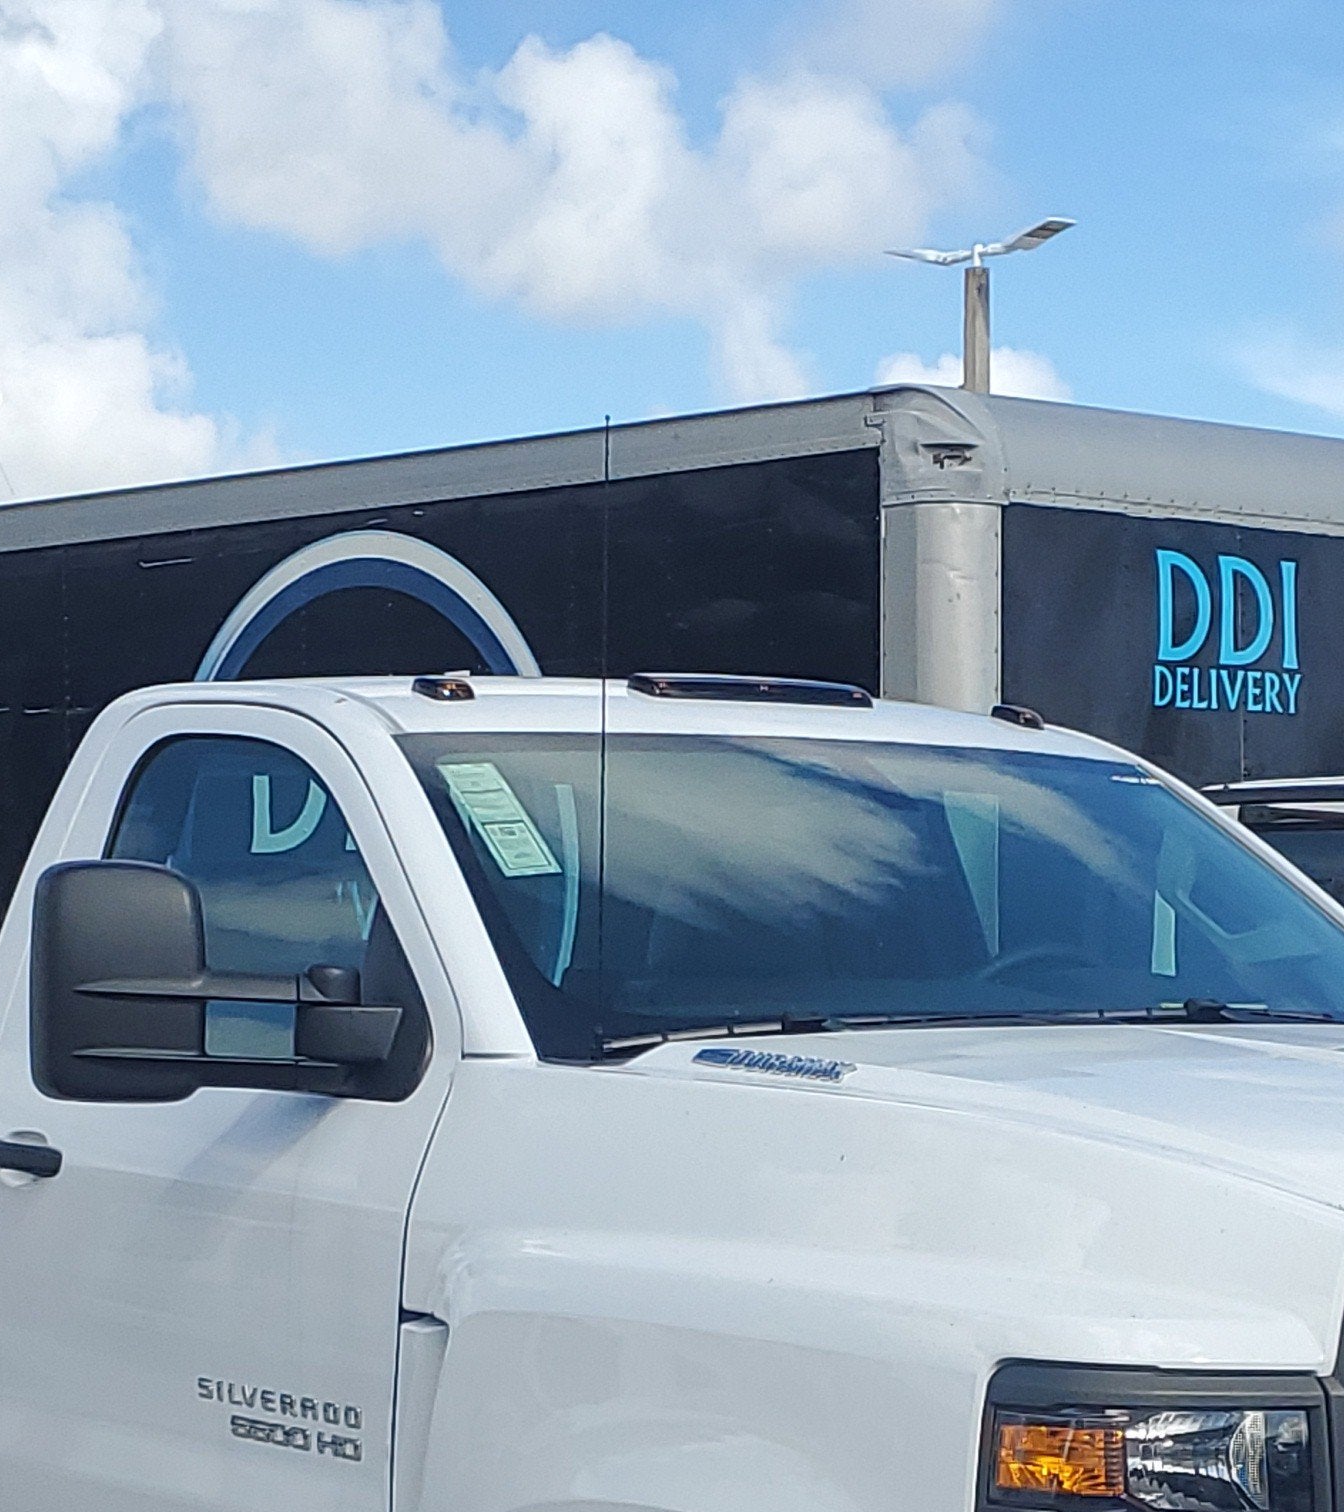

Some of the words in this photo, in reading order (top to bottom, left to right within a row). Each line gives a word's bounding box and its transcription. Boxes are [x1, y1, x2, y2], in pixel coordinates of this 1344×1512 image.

[1155, 547, 1300, 670] DDI
[1153, 664, 1302, 714] DELIVERY
[196, 1376, 363, 1430] SILVERADO
[316, 1429, 363, 1463] HD
